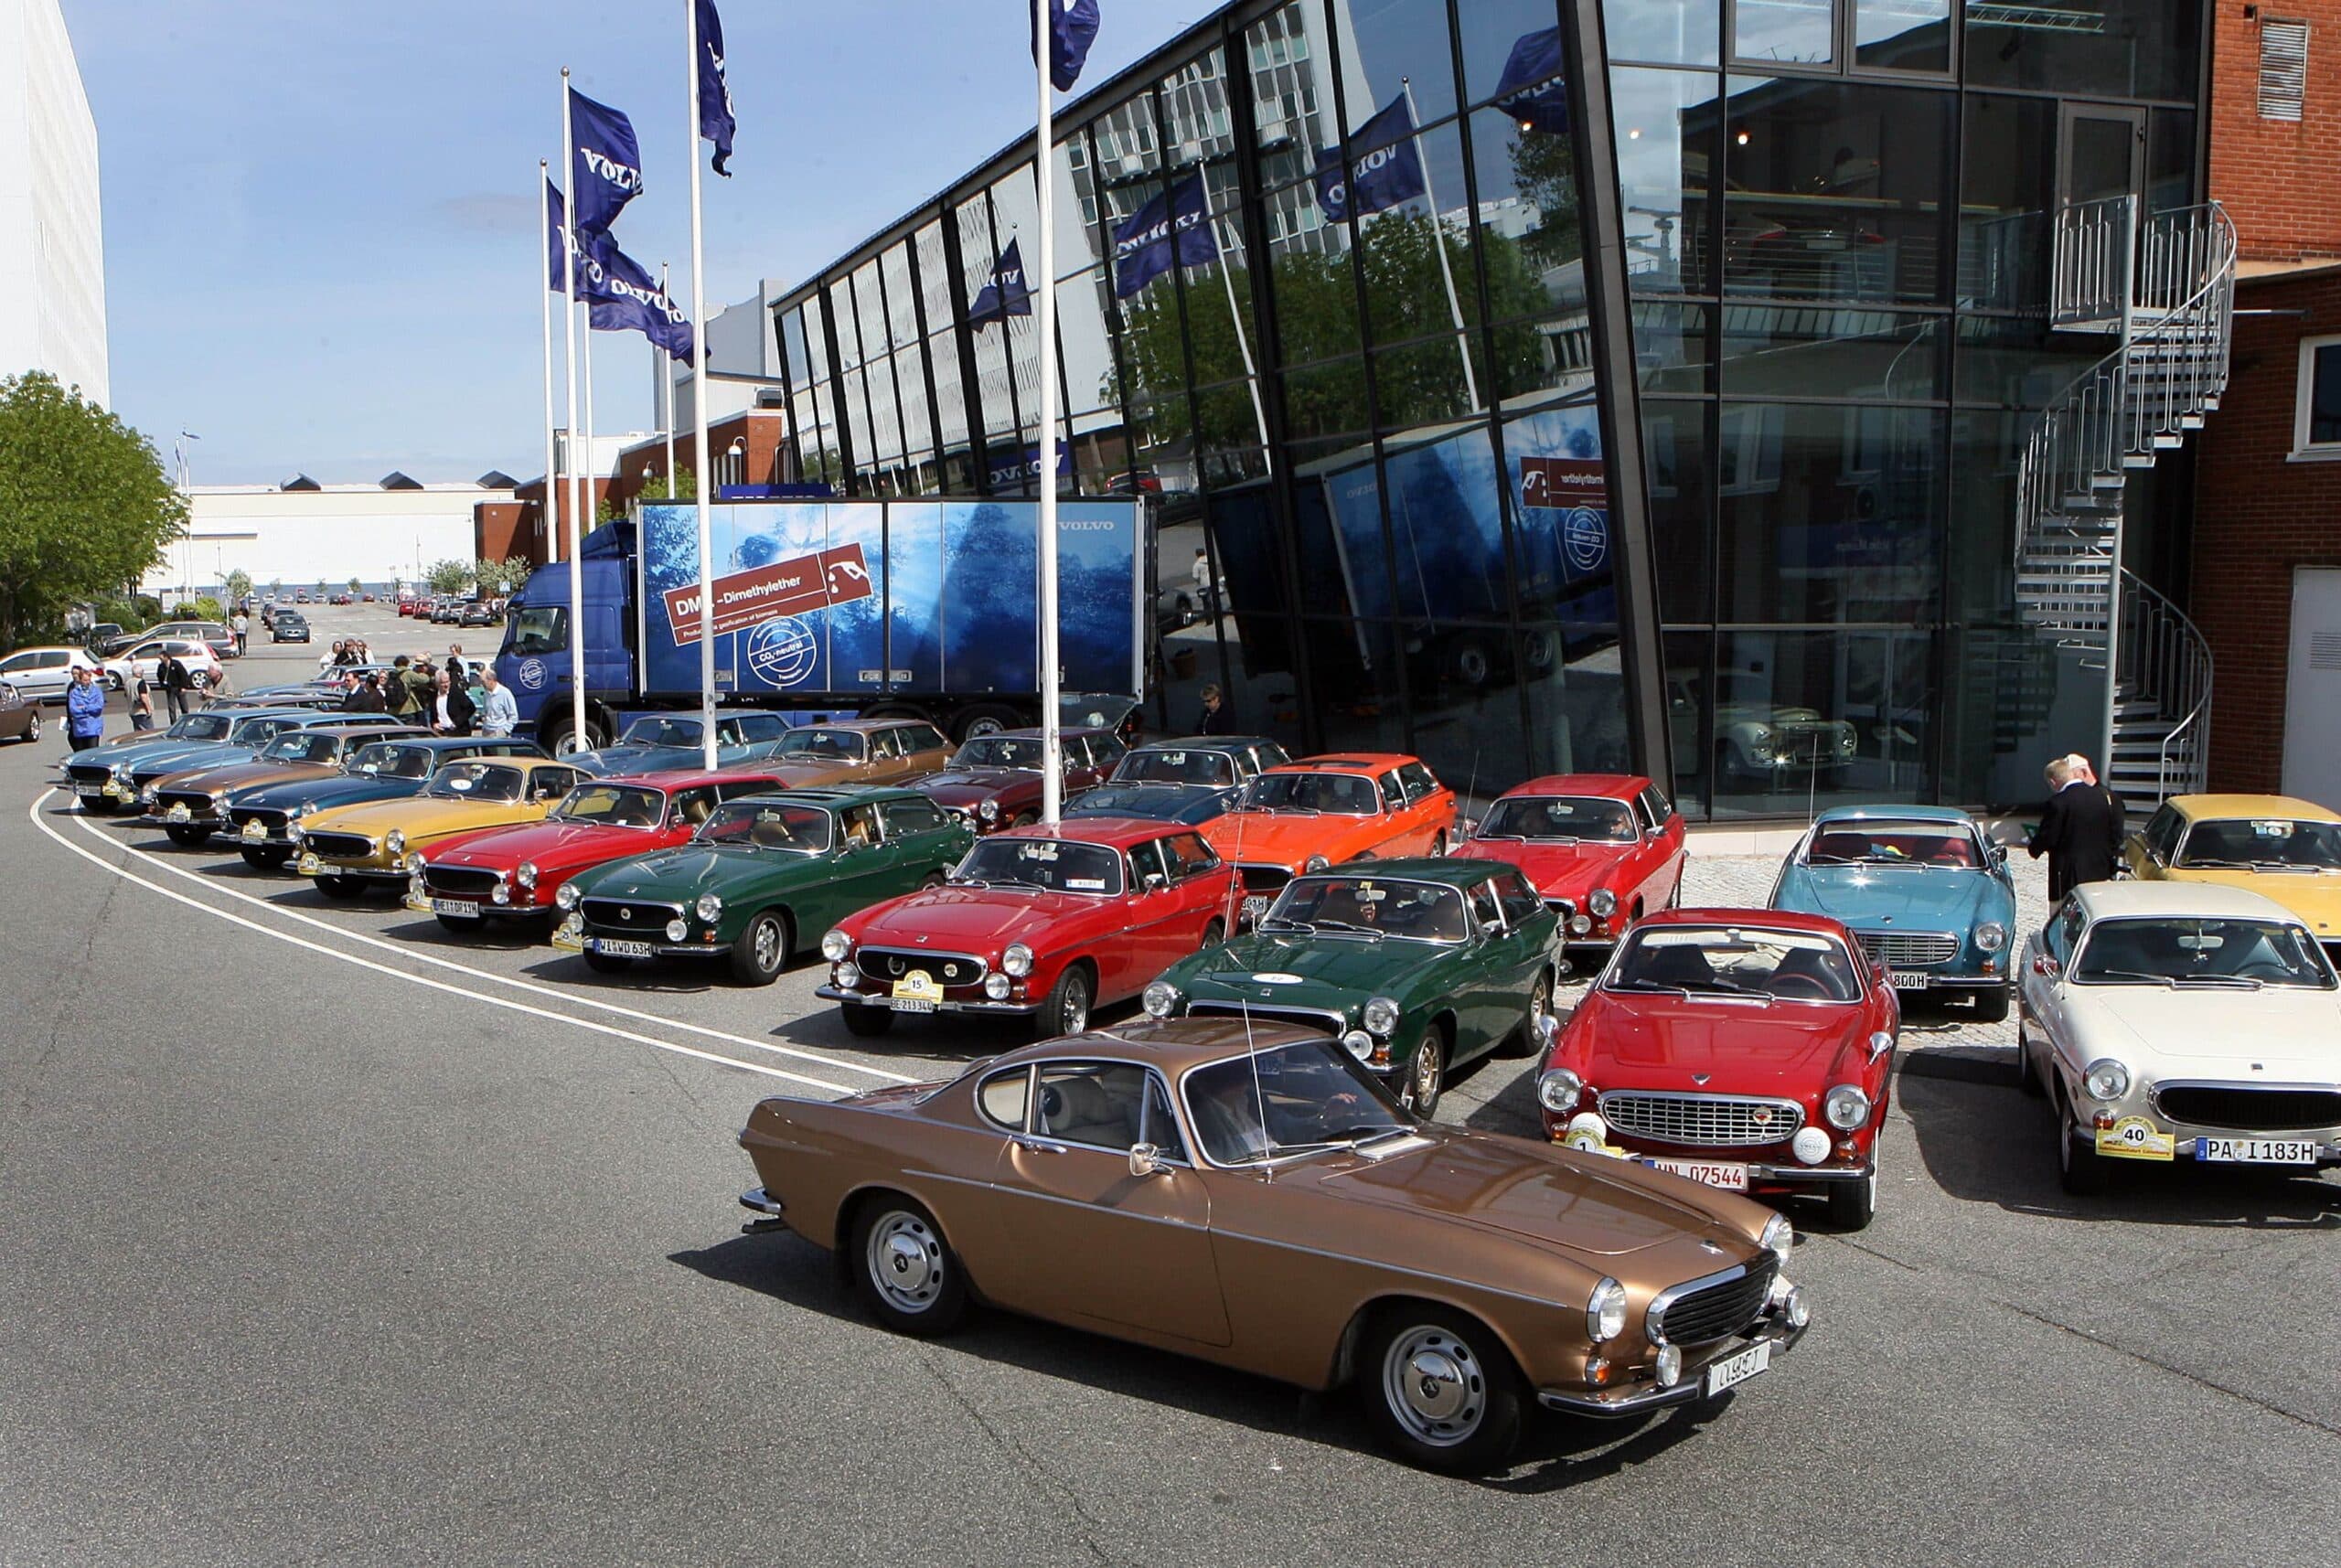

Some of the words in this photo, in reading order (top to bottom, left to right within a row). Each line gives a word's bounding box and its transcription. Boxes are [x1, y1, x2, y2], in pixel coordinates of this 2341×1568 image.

[1059, 520, 1115, 531] VOLVO
[632, 942, 651, 956] 63H
[913, 979, 923, 989] 15
[2124, 1128, 2145, 1142] 40
[2208, 1140, 2232, 1158] PA
[2262, 1142, 2314, 1160] 183H
[1690, 1166, 1742, 1185] 07544
